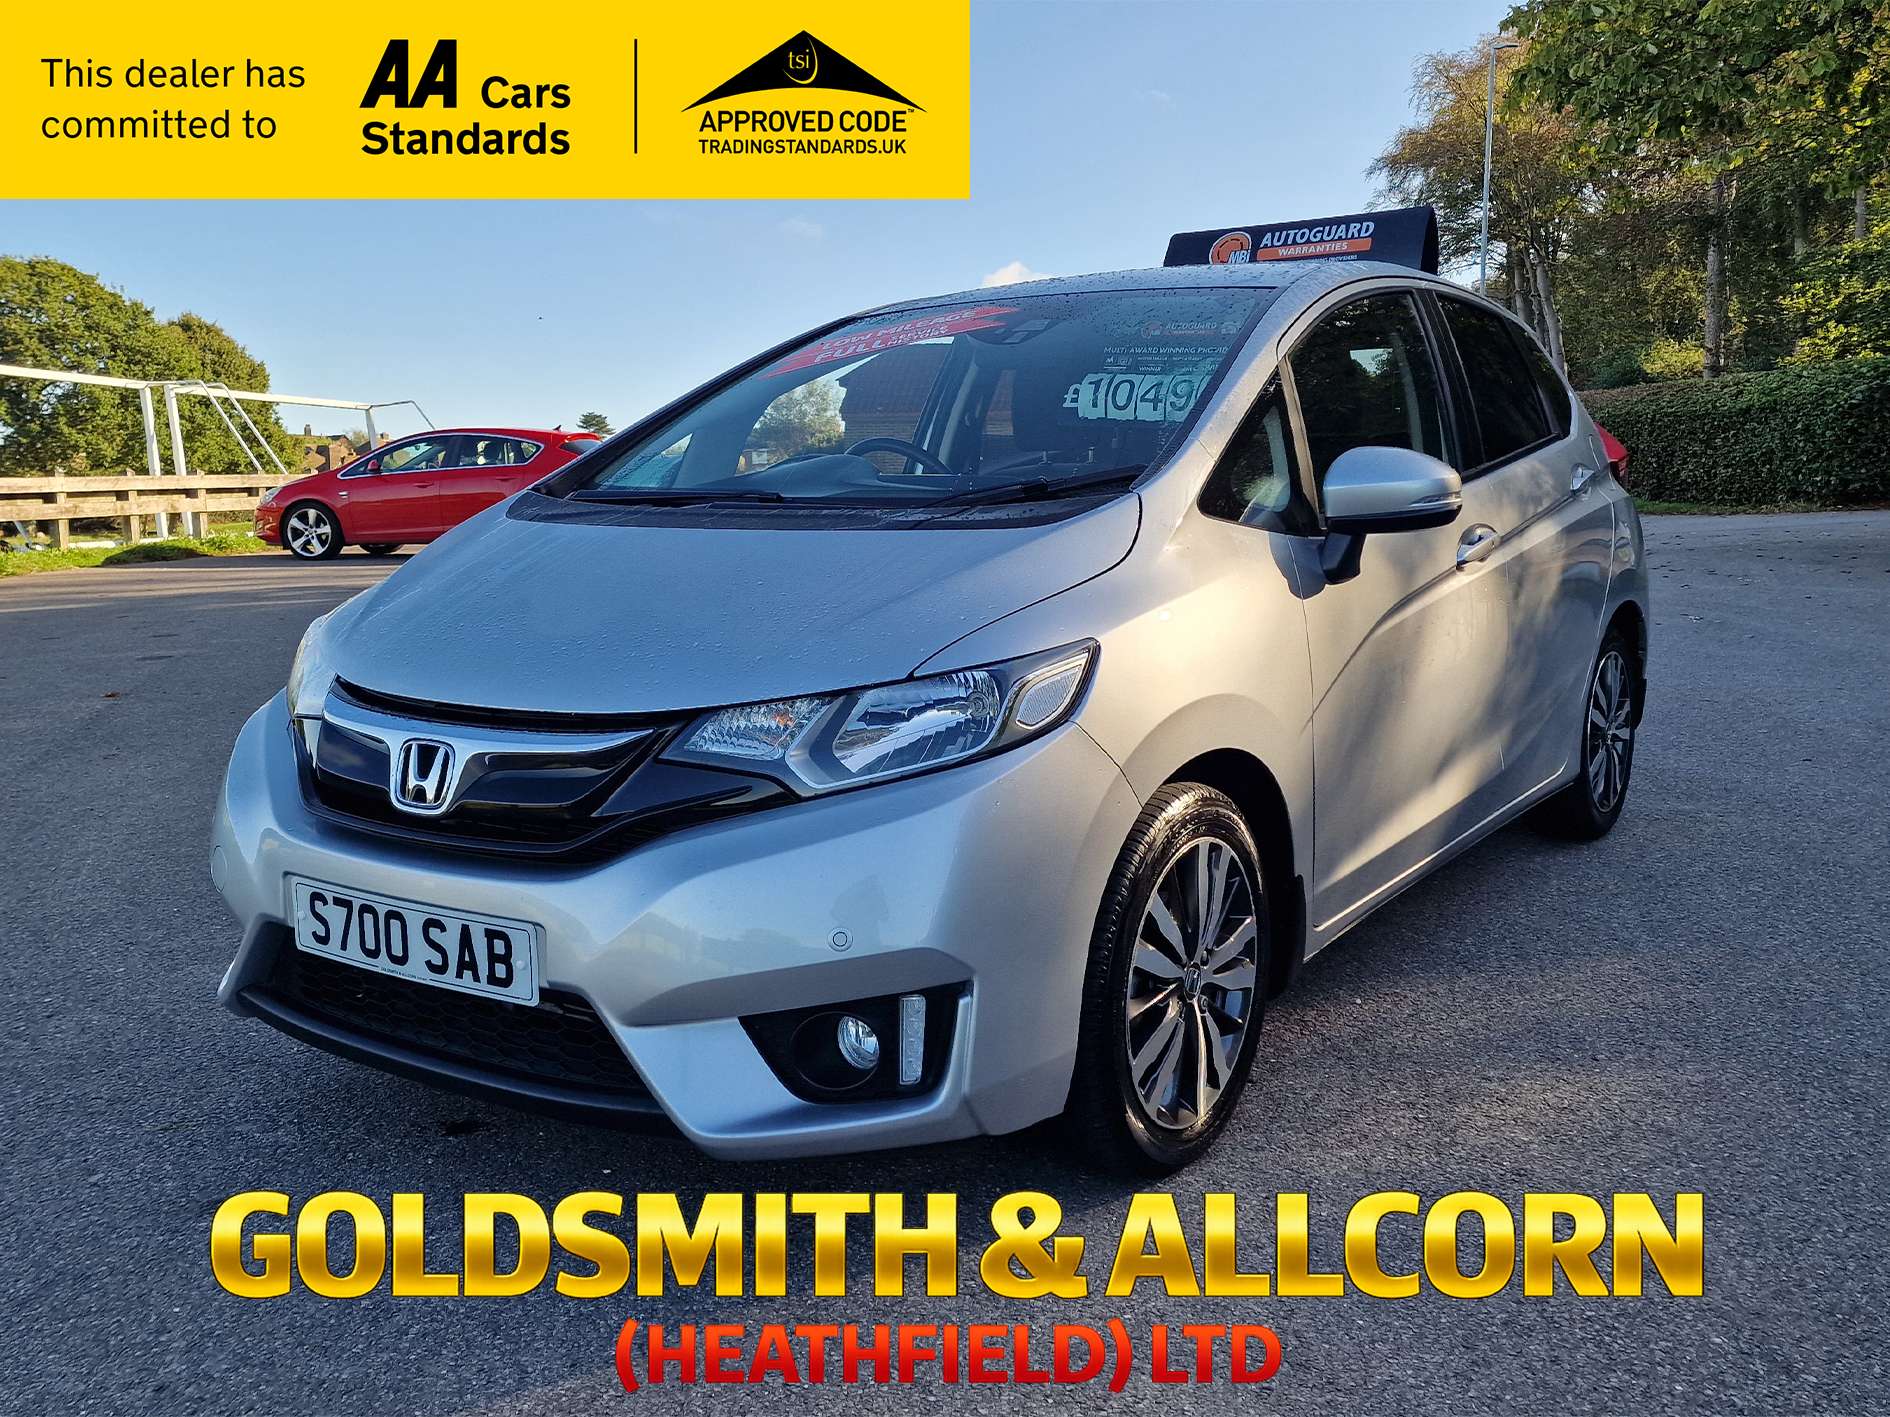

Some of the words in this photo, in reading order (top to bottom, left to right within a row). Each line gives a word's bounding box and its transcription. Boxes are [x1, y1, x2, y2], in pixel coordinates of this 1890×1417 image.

[1260, 221, 1375, 248] AUTOGUARD
[1278, 241, 1348, 257] WARRANTIES
[309, 891, 409, 967] S700
[422, 917, 514, 989] SAB
